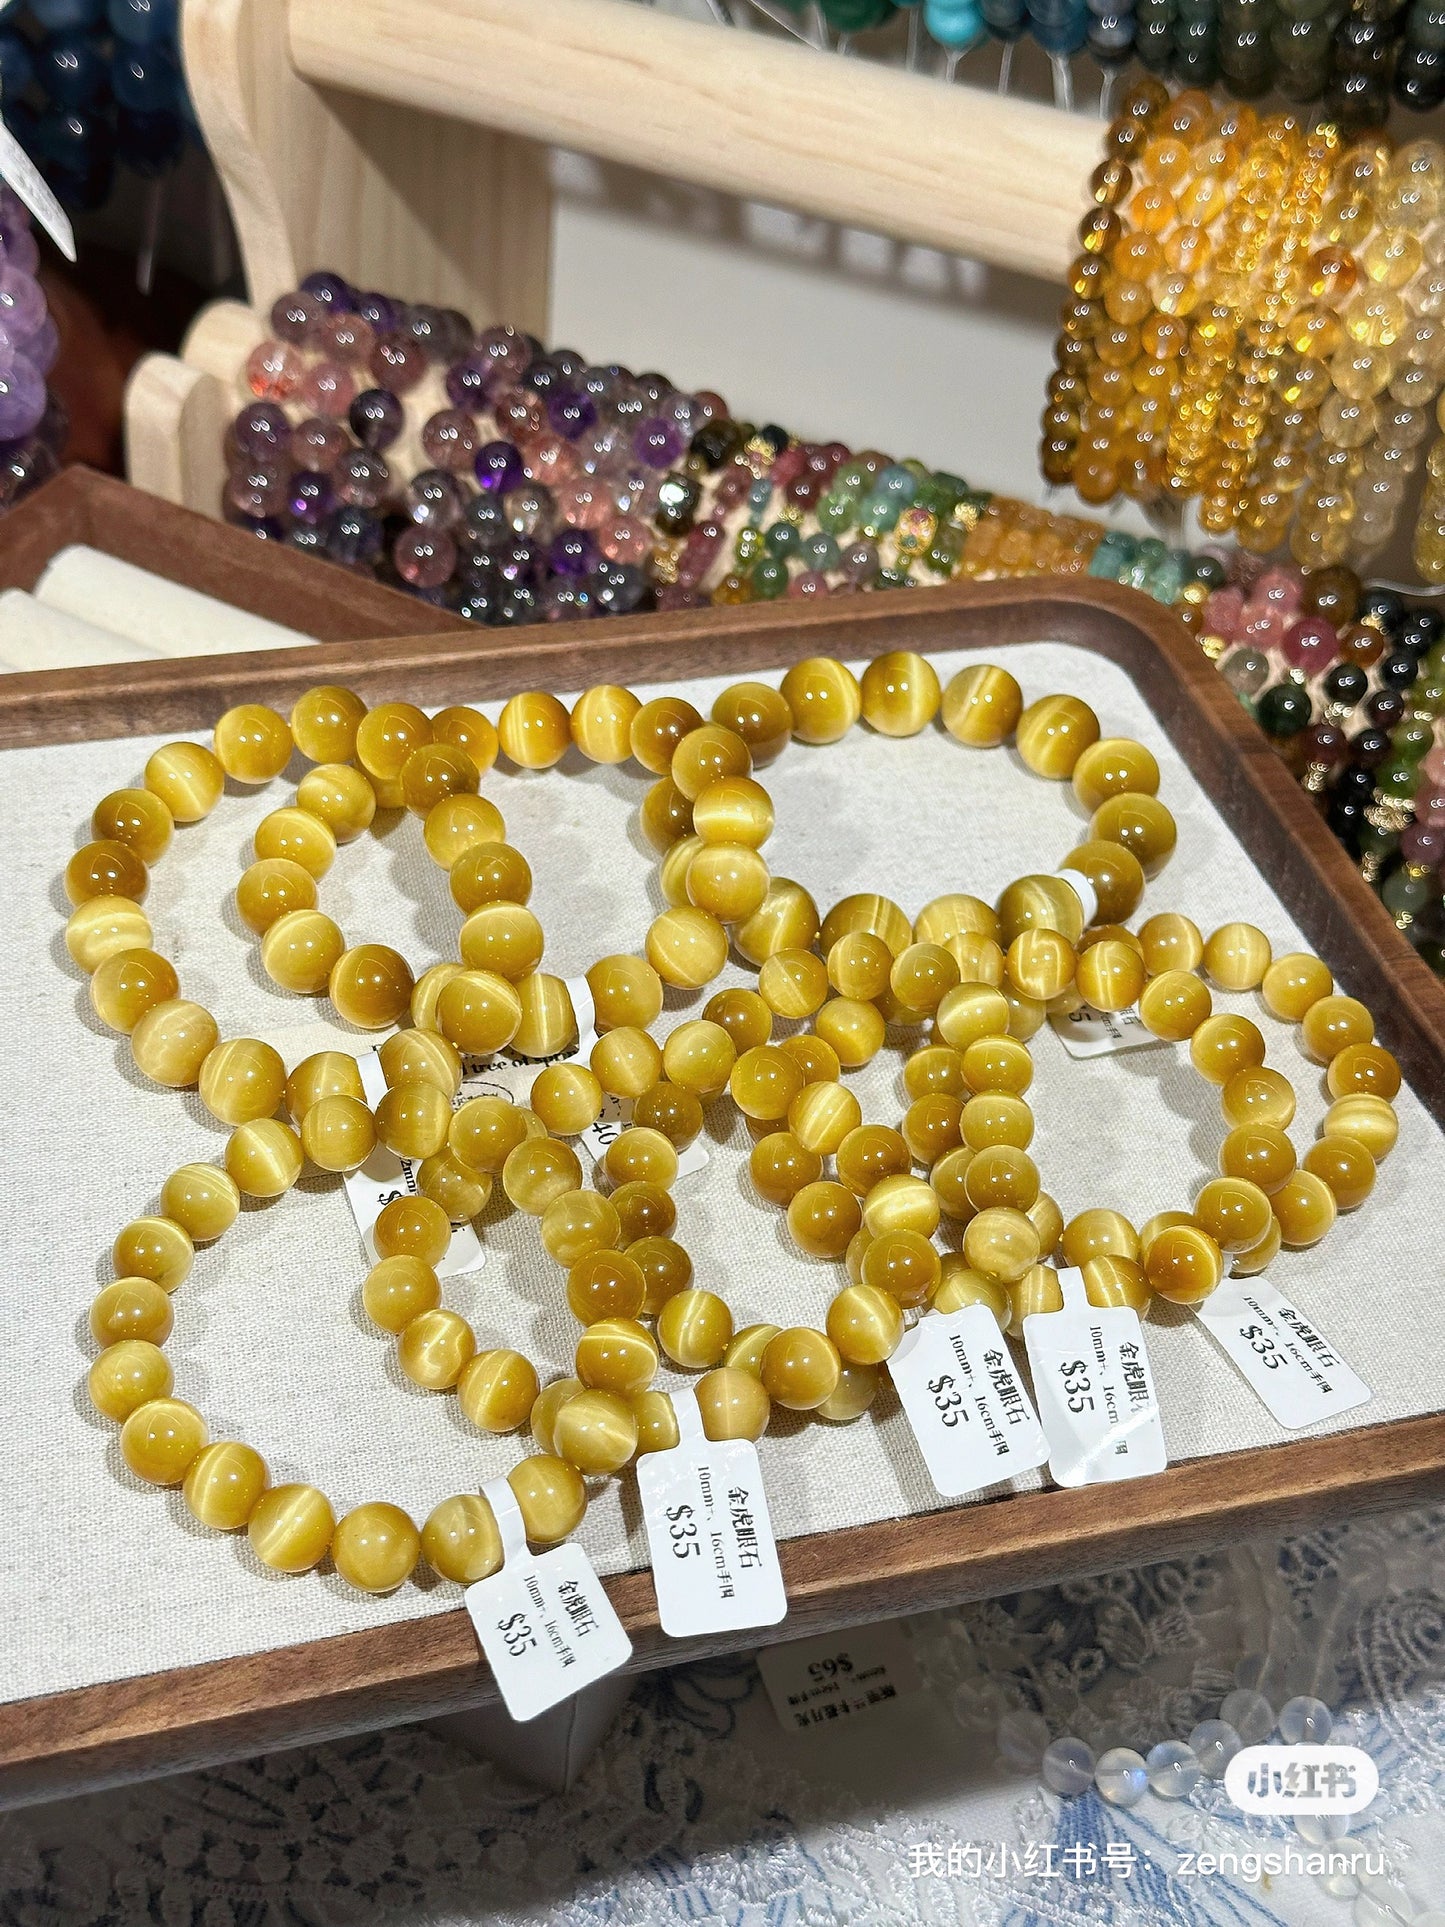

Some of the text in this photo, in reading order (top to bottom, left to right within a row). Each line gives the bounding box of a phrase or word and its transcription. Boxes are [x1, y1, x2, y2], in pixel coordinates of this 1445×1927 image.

[592, 1119, 619, 1145] 40
[1239, 1324, 1289, 1370] $35
[1278, 1307, 1340, 1368] 金虎眼石
[926, 1374, 970, 1428] $35
[983, 1349, 1030, 1425] 金虎眼石
[1057, 1359, 1095, 1414] $35
[665, 1504, 701, 1559] $35
[728, 1486, 763, 1569] 金虎眼石
[496, 1613, 538, 1657] $35
[558, 1580, 599, 1637] 金虎眼石
